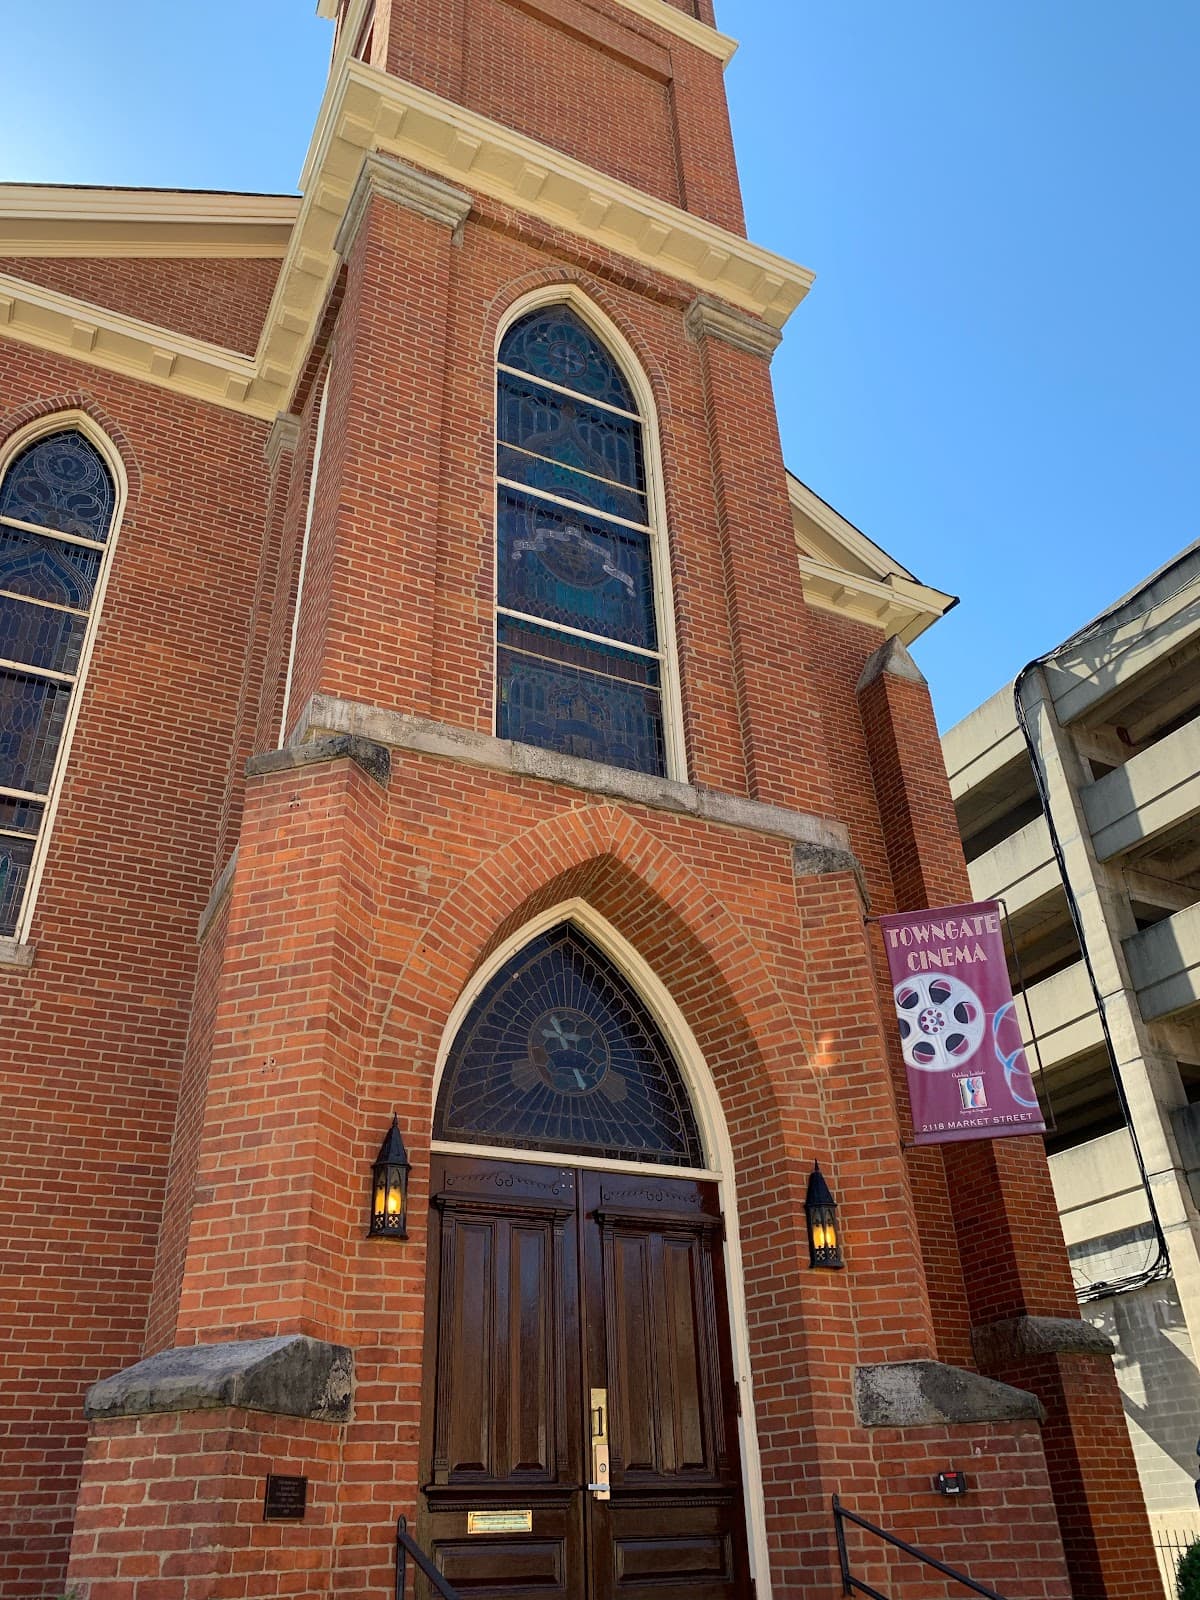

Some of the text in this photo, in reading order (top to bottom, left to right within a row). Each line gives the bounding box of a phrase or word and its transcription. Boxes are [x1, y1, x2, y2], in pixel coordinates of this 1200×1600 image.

[886, 914, 999, 948] TOWNGATE
[907, 942, 989, 972] CINEMA
[922, 1112, 1033, 1132] 2118 MARKET STREET
